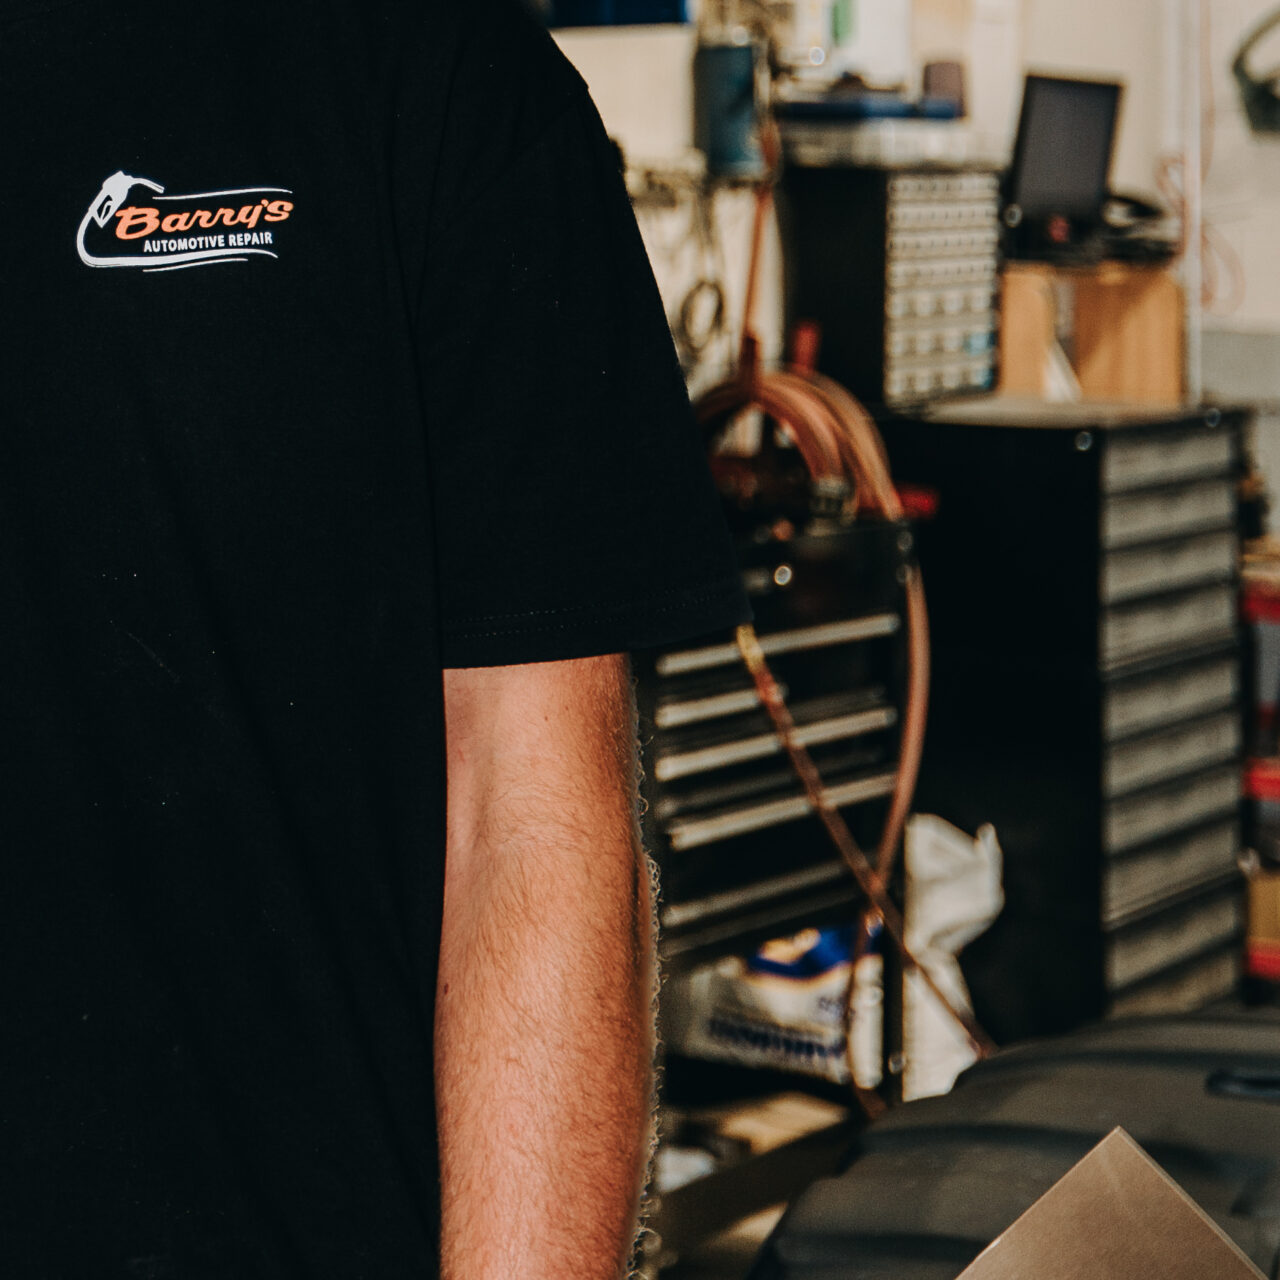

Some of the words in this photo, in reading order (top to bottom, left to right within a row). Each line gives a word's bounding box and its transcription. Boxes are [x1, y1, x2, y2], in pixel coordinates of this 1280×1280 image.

[115, 199, 294, 240] Barry's
[143, 234, 225, 253] AUTOMOTIVE
[228, 232, 273, 246] REPAIR
